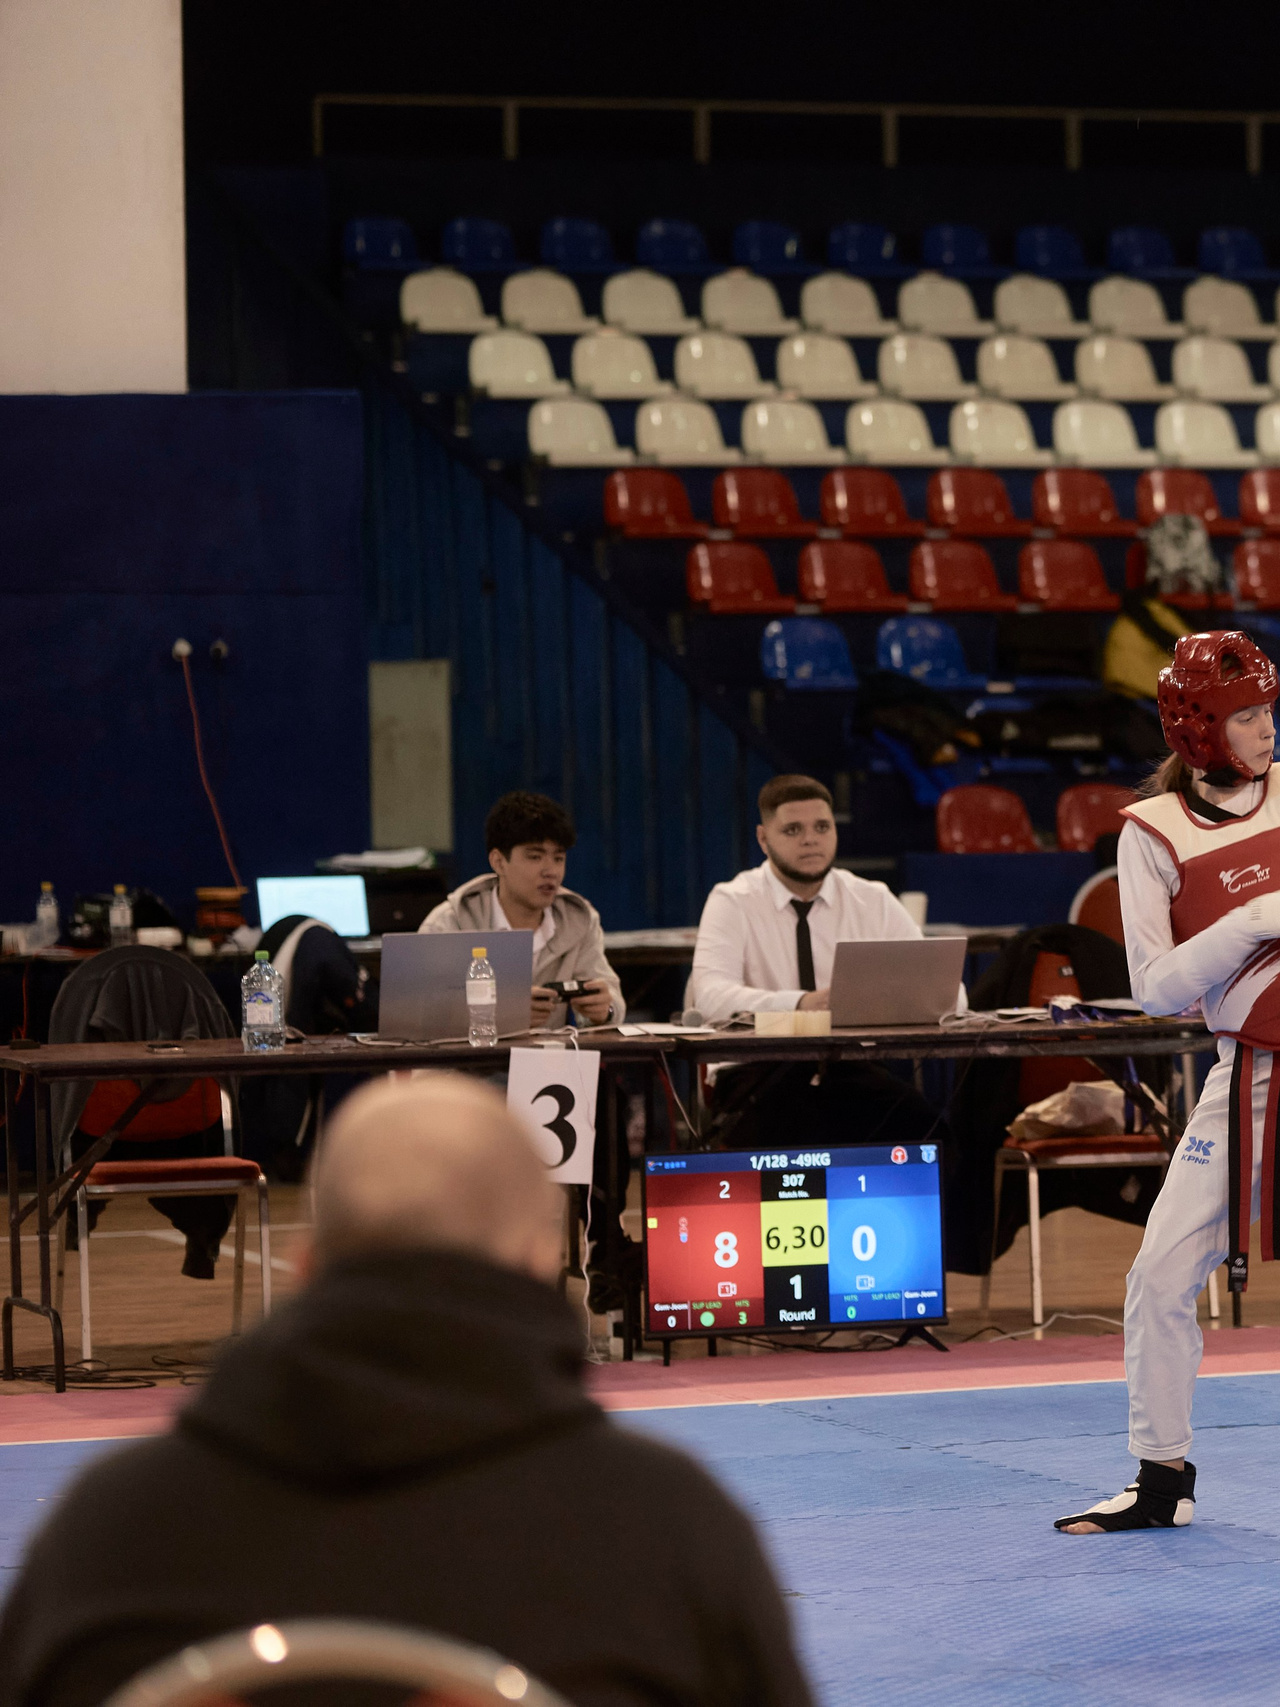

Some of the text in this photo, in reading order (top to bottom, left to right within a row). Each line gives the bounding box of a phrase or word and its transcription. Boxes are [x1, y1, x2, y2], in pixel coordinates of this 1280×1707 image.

[1256, 867, 1270, 878] WT
[531, 1084, 577, 1170] 3
[750, 1152, 831, 1170] 1/128 -49KG
[1181, 1153, 1210, 1166] KPNP
[782, 1173, 805, 1187] 307
[857, 1175, 866, 1192] 1
[719, 1180, 731, 1199] 2
[766, 1225, 825, 1254] 6,30
[852, 1225, 877, 1261] 0
[714, 1231, 739, 1268] 8
[789, 1274, 802, 1300] 1
[779, 1308, 816, 1322] Round
[847, 1306, 857, 1319] 0
[917, 1303, 926, 1315] 0
[667, 1315, 677, 1328] 0
[738, 1311, 748, 1325] 3
